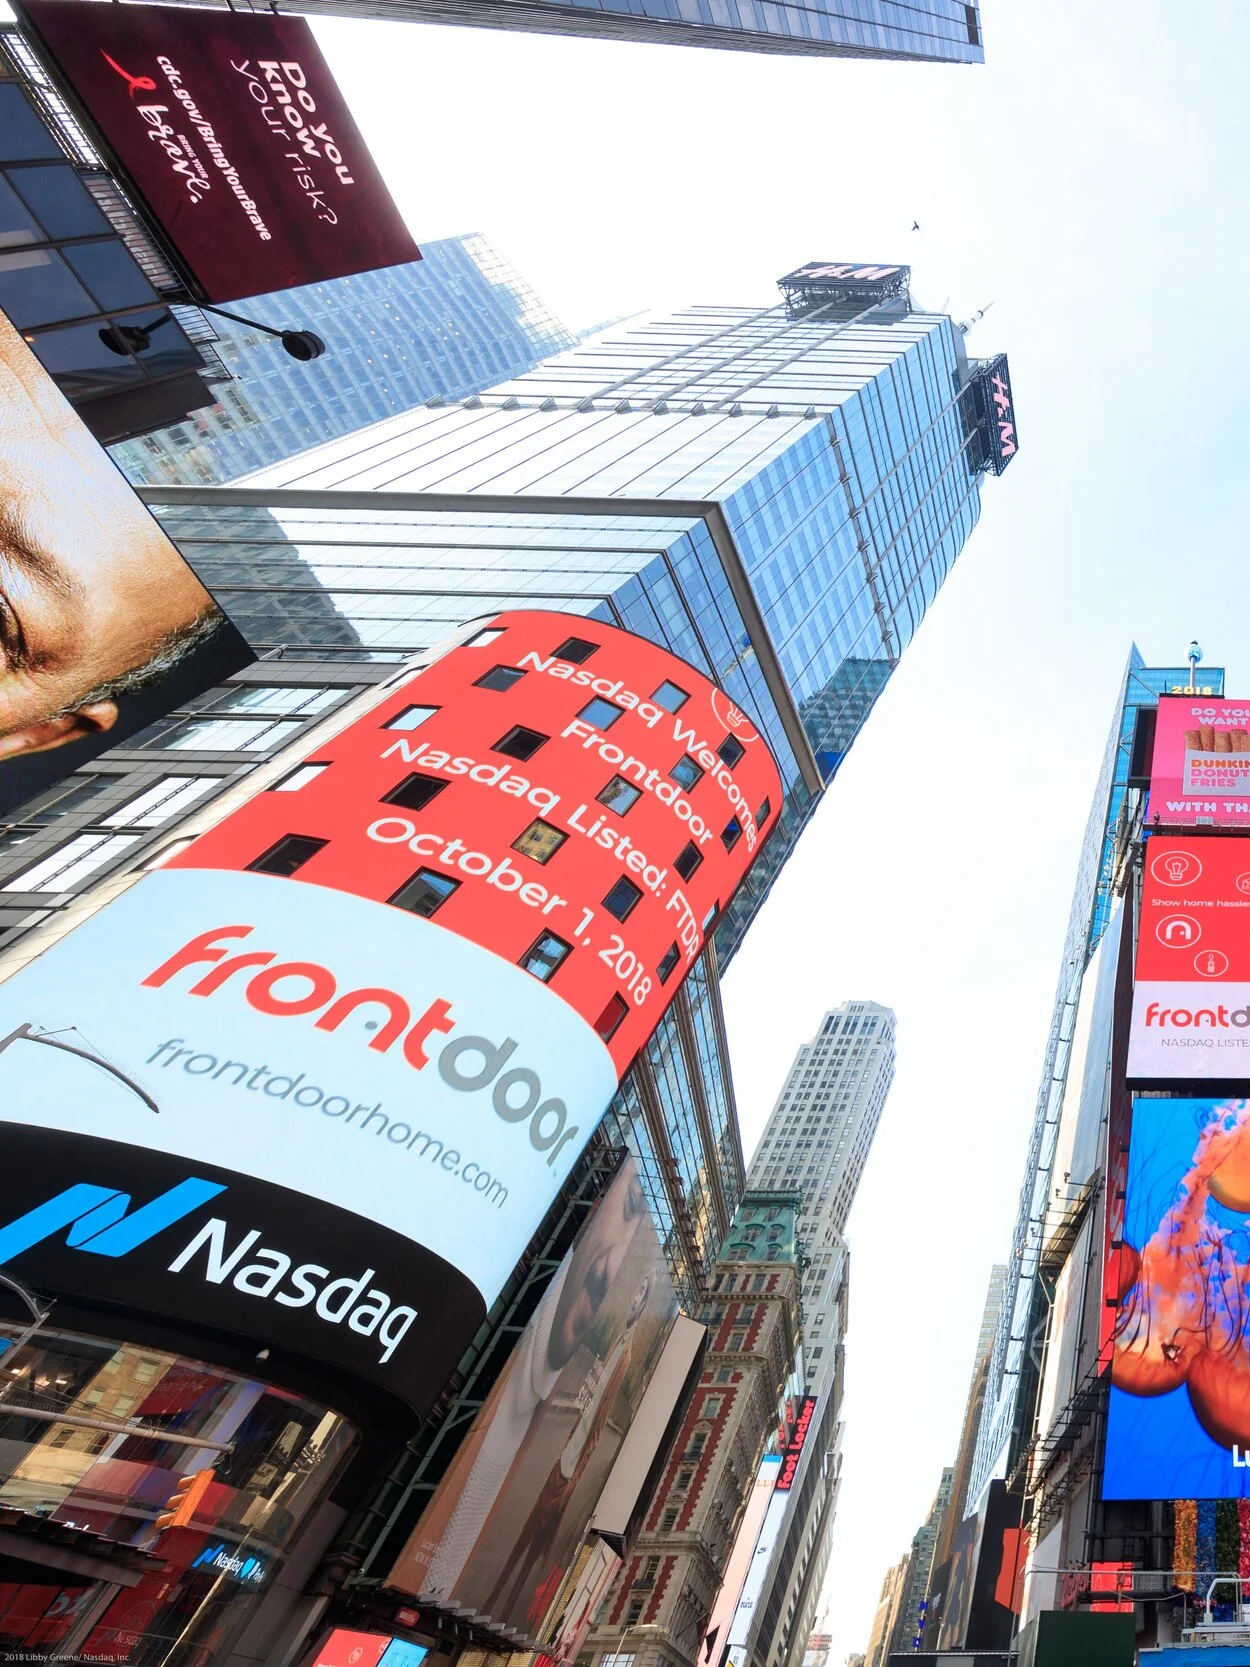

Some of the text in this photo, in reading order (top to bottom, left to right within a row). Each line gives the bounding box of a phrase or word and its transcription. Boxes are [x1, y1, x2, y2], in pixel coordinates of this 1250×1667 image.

[157, 55, 272, 241] cdc.gov/BringYourBrave
[230, 59, 338, 225] your risk?
[257, 60, 322, 158] know
[280, 61, 355, 185] Do you
[176, 134, 209, 179] BRING YOUR
[991, 372, 1016, 456] H&M
[1171, 685, 1213, 695] 2018
[1191, 707, 1216, 717] DO
[1199, 716, 1249, 726] WANT
[517, 649, 760, 857] Nasdaq Welcomes
[560, 717, 715, 848] Frontdoor
[1190, 778, 1236, 788] FRIES
[1191, 768, 1250, 778] DONUT
[380, 737, 700, 961] Nasdaq Listed: FTDR
[1165, 801, 1217, 812] WITH
[366, 816, 654, 1008] October 1, 2018
[1151, 898, 1181, 907] Show
[1183, 899, 1214, 907] home
[139, 924, 584, 1168] frontdoor
[1161, 1038, 1215, 1049] NASDAQ
[144, 1037, 510, 1210] frontdoorhome.com
[167, 1215, 418, 1365] Nasdaq
[777, 1454, 799, 1489] Foot
[789, 1399, 815, 1450] Locker
